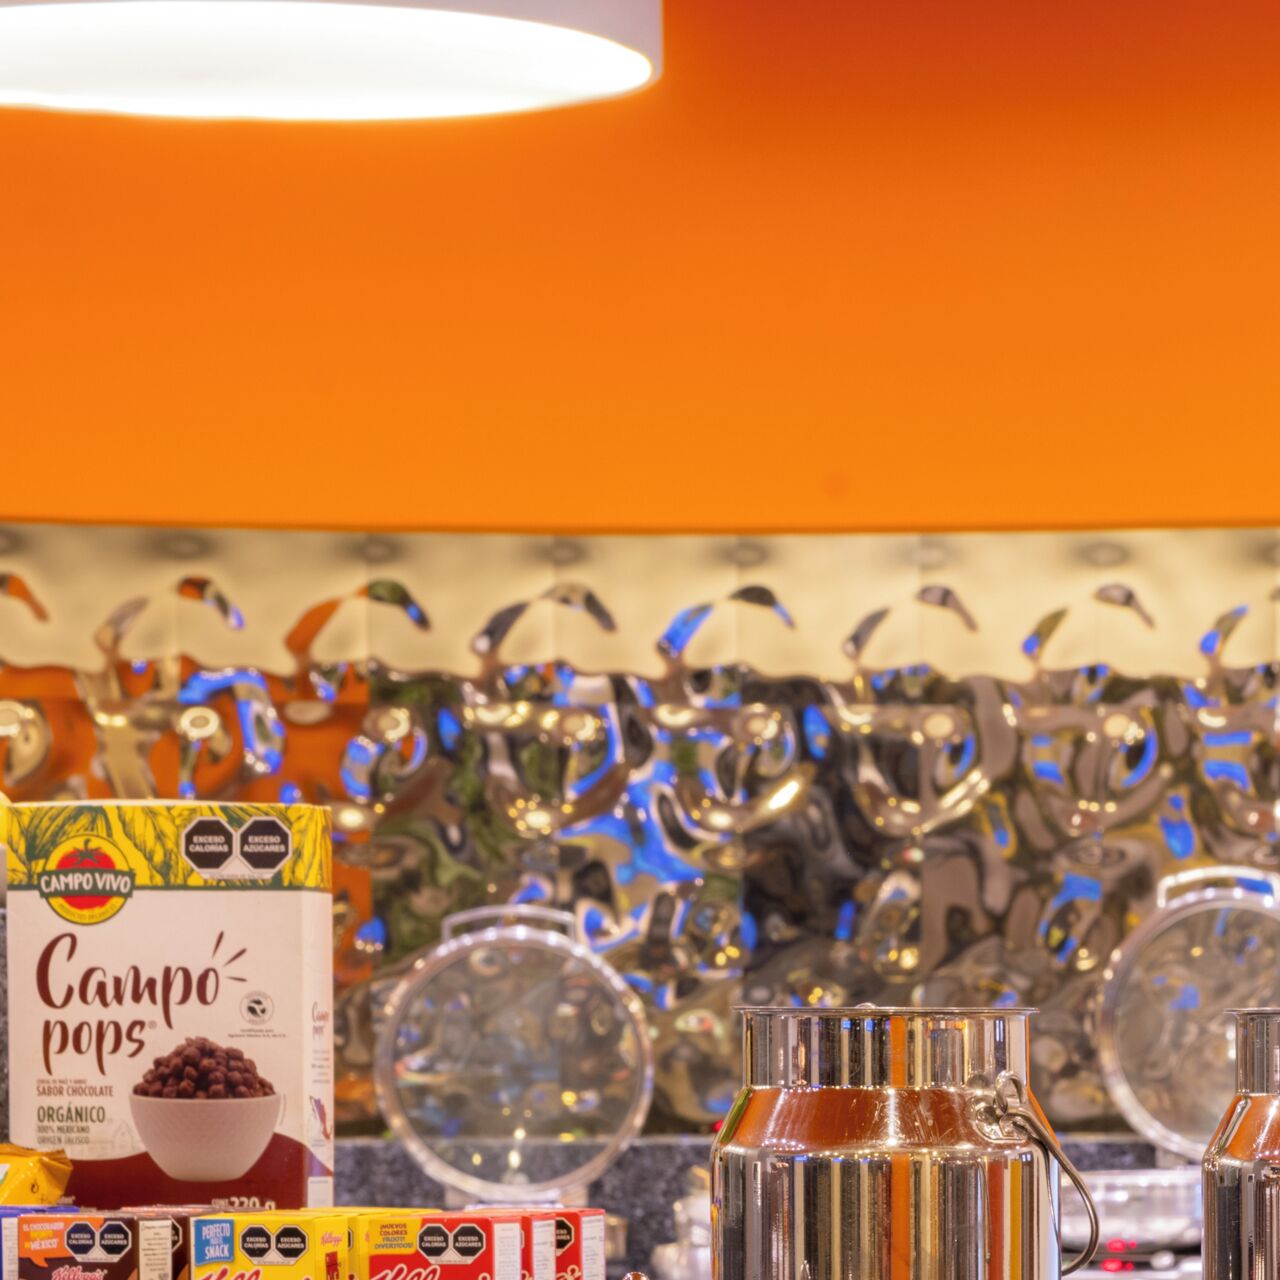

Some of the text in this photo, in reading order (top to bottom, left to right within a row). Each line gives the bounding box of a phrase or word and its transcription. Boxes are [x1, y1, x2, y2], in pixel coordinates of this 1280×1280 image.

[192, 835, 226, 844] EXCESO
[247, 835, 282, 844] EXCESO
[188, 843, 230, 853] CALORÍAS
[242, 843, 286, 853] AZÚCARES
[39, 871, 132, 894] CAMPO VIVO
[36, 932, 219, 1029] Campo
[42, 1018, 146, 1077] pops
[36, 1085, 114, 1097] SABOR CHOCOLATE
[37, 1102, 106, 1123] ORGÁNICO
[201, 1222, 231, 1241] PERFECTO
[204, 1244, 230, 1260] SNACK
